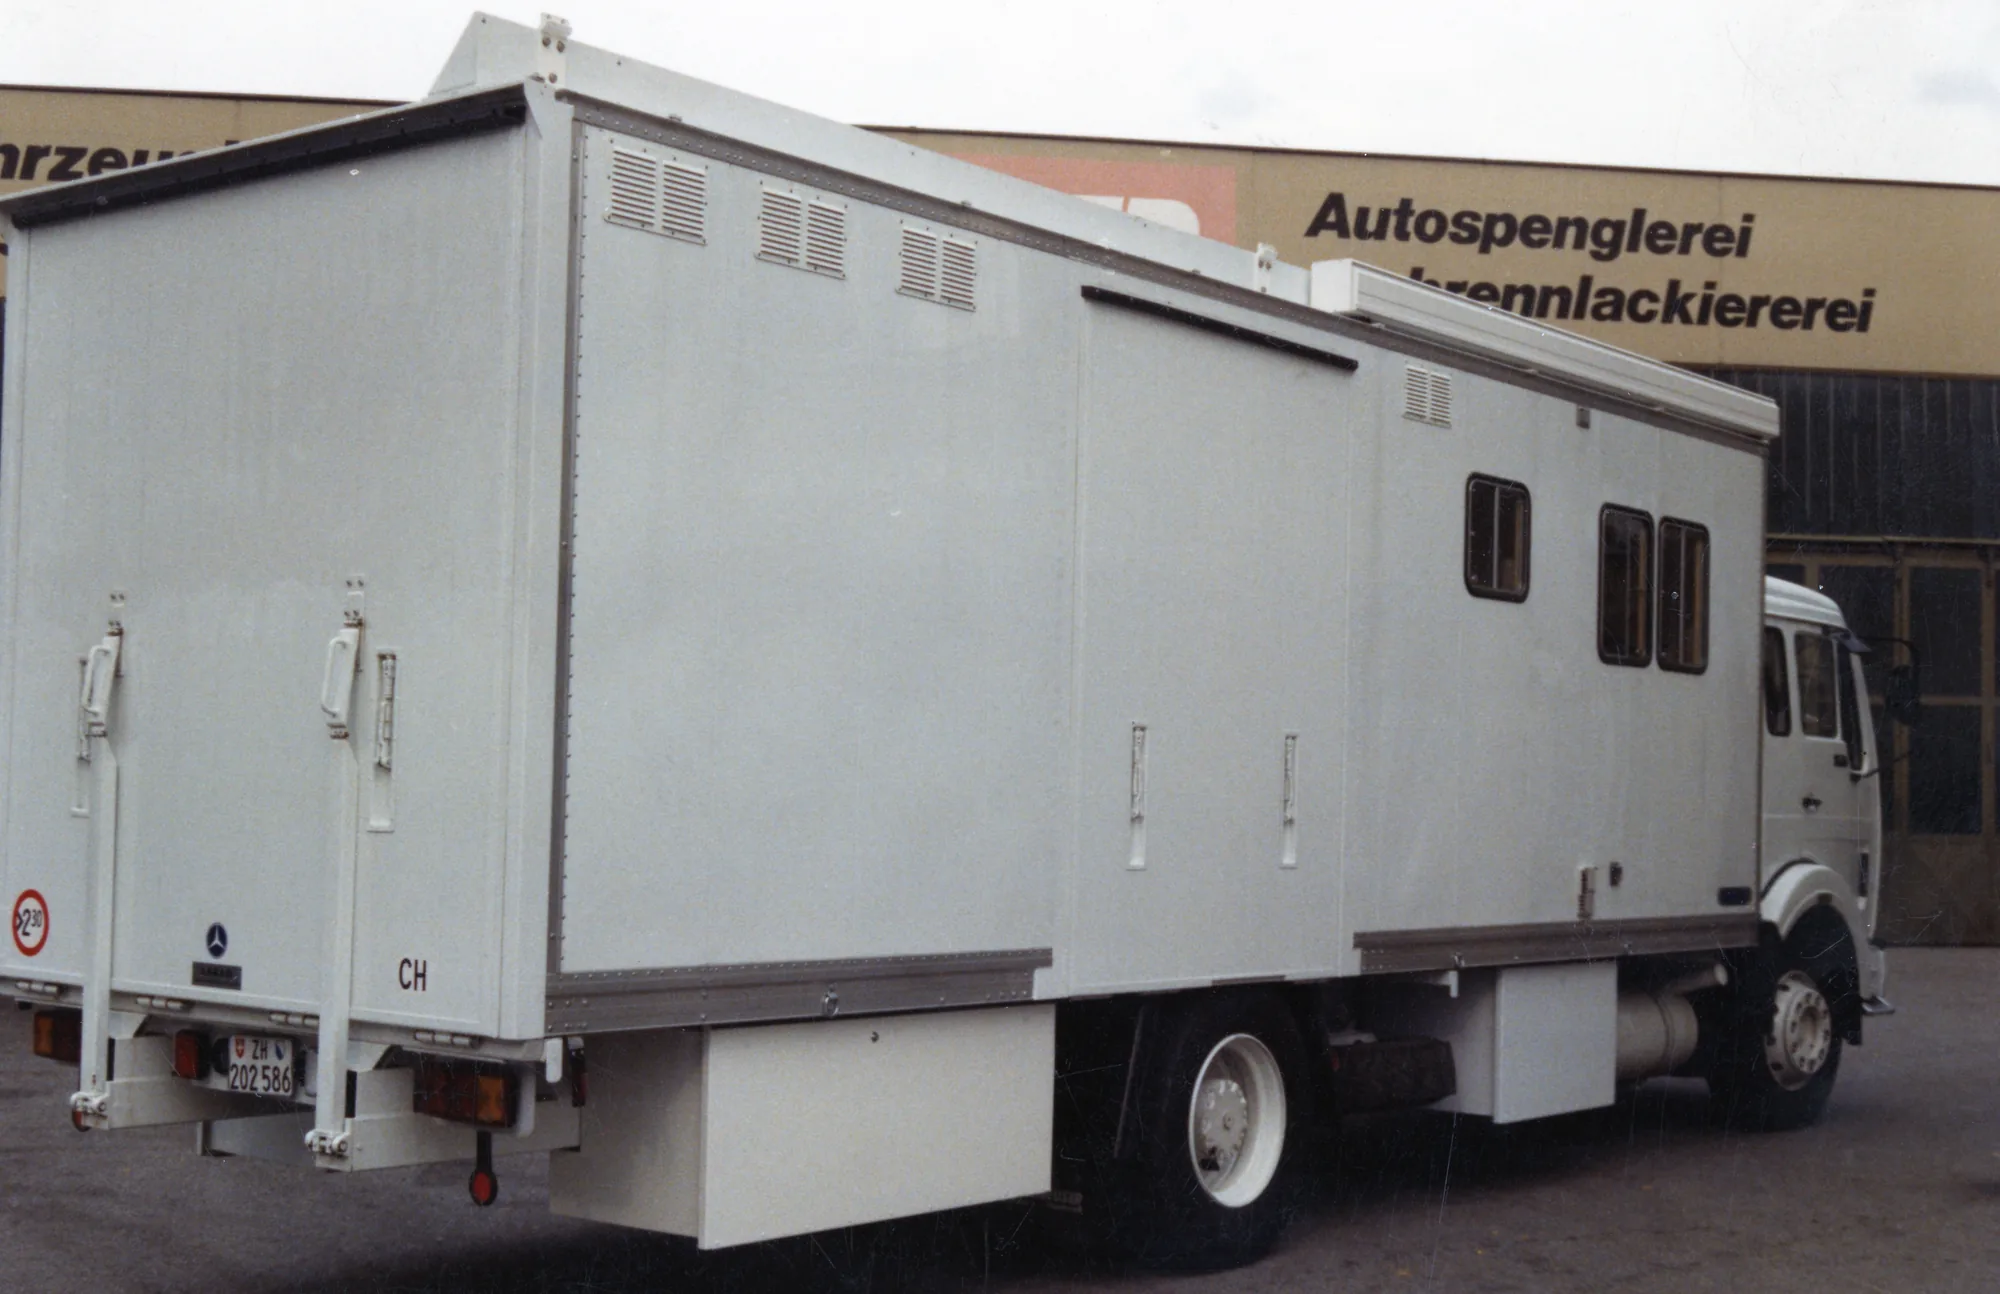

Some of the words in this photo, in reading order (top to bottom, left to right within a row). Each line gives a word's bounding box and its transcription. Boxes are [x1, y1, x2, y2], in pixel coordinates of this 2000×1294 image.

[1304, 192, 1755, 262] Autospenglerei
[399, 957, 427, 991] CH
[251, 1039, 268, 1060] ZH
